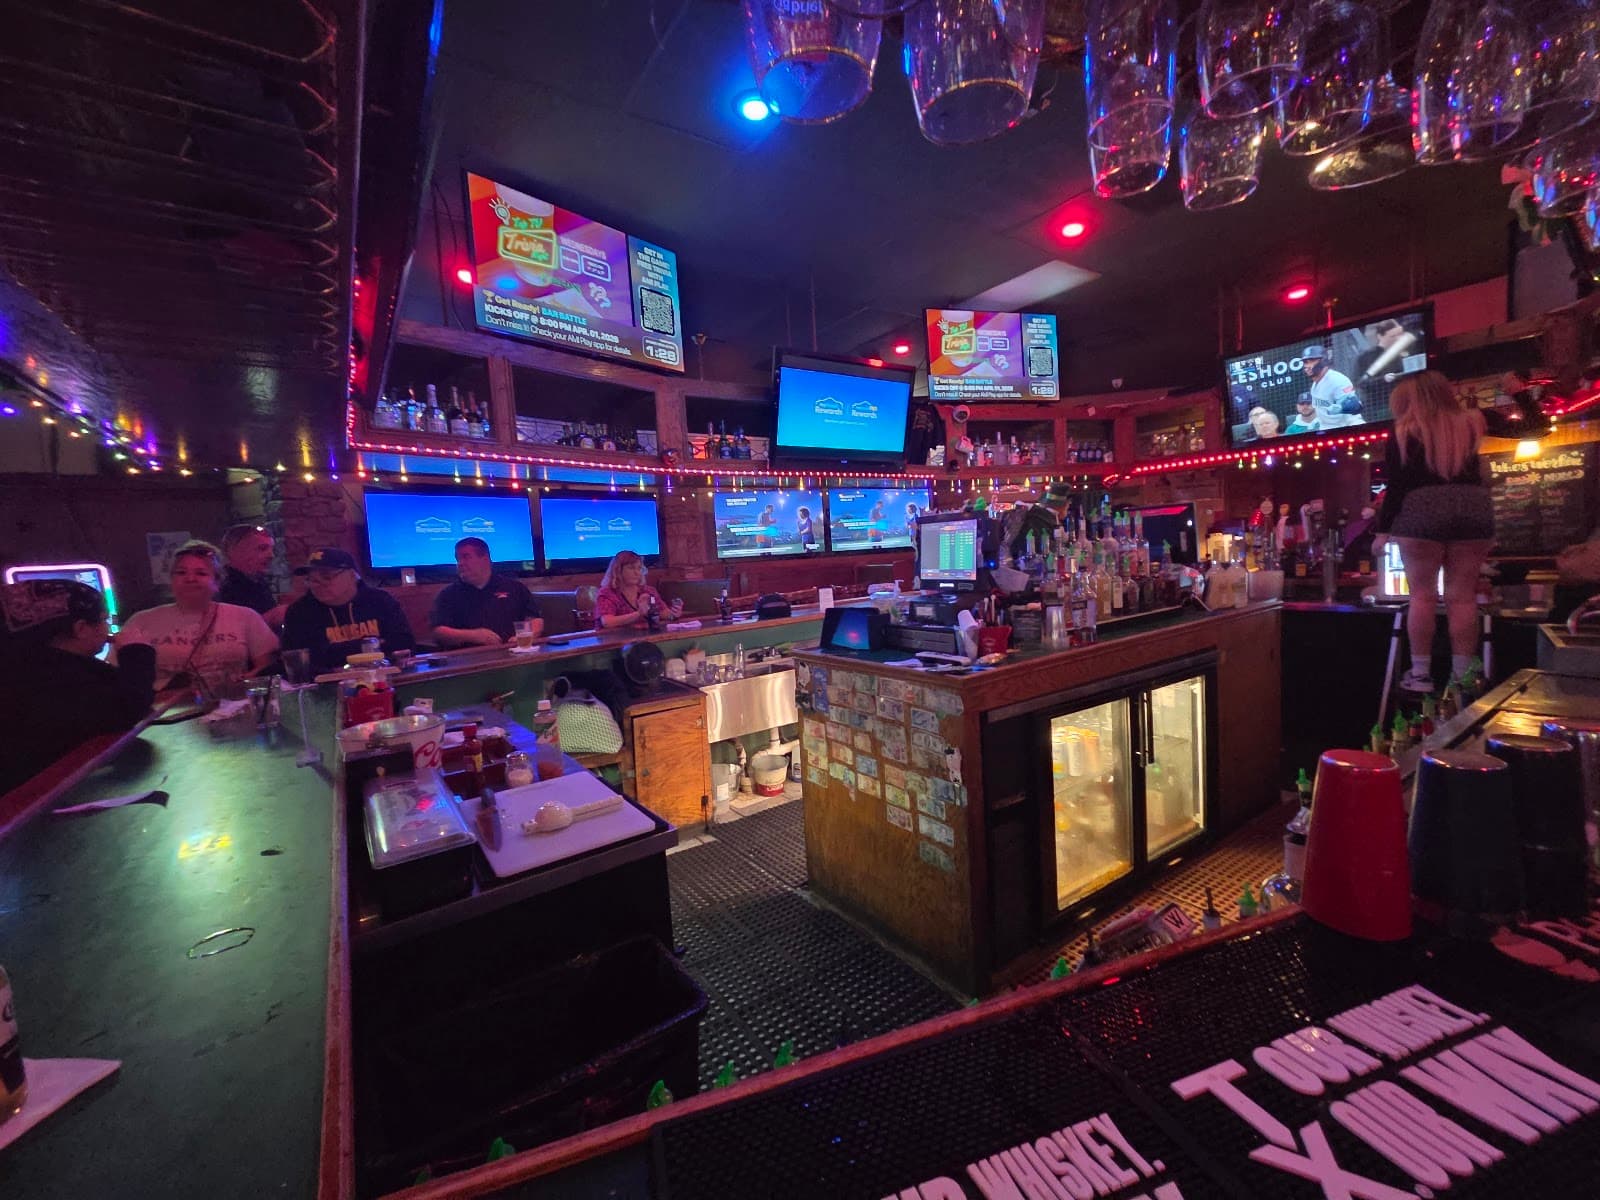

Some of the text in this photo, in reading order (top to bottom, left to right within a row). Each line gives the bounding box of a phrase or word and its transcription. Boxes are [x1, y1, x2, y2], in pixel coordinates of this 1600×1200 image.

[504, 233, 546, 252] Trivia
[484, 303, 513, 318] KICKS
[513, 310, 531, 321] OFF
[559, 321, 572, 332] PM
[511, 298, 541, 314] Ready!
[560, 312, 587, 326] BATTLE
[485, 314, 506, 327] Don't
[530, 325, 553, 337] Check
[553, 330, 567, 341] your
[1261, 376, 1292, 388] CLUB
[1252, 983, 1491, 1096] OUR WHISKEY.
[1329, 1025, 1600, 1191] OUR WAY
[966, 1112, 1166, 1200] WHISKEY.
